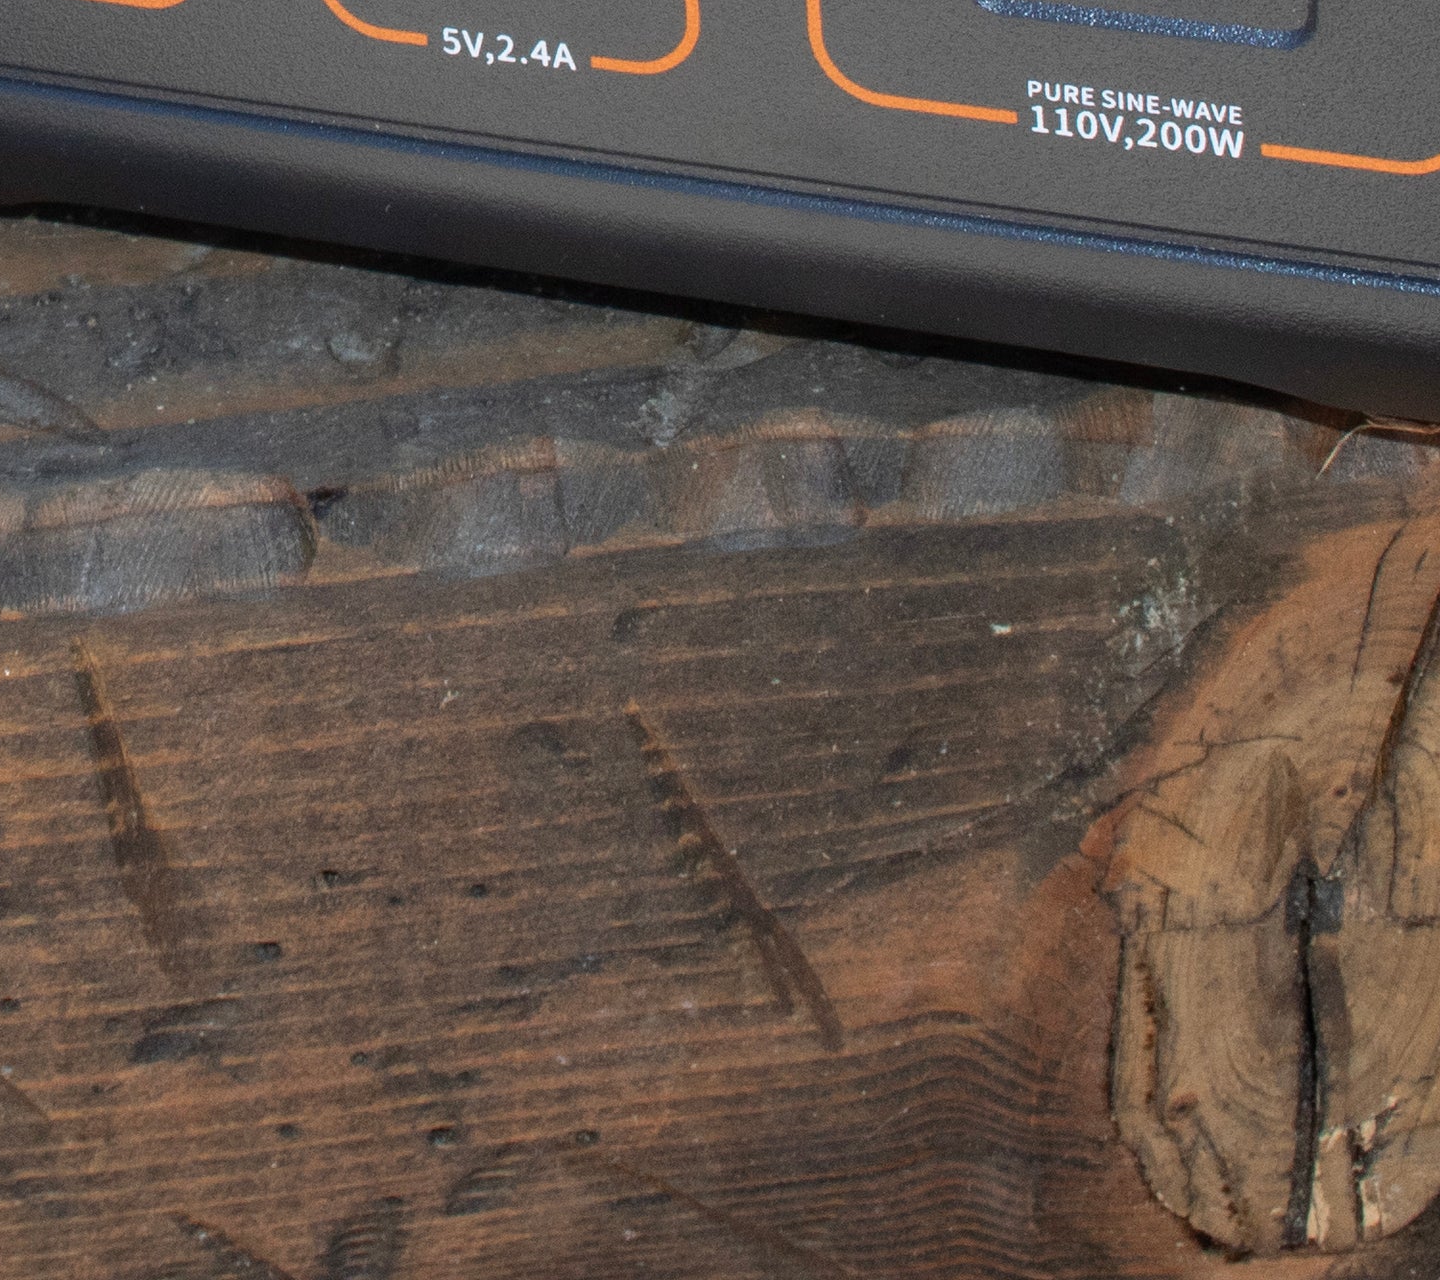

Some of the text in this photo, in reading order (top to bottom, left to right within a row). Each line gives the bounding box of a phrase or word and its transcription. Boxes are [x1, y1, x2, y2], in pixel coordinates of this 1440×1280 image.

[441, 26, 579, 73] 5V,2.4A
[1026, 79, 1244, 126] PURE SINE-WAVE
[1030, 104, 1245, 159] 110V,200W
